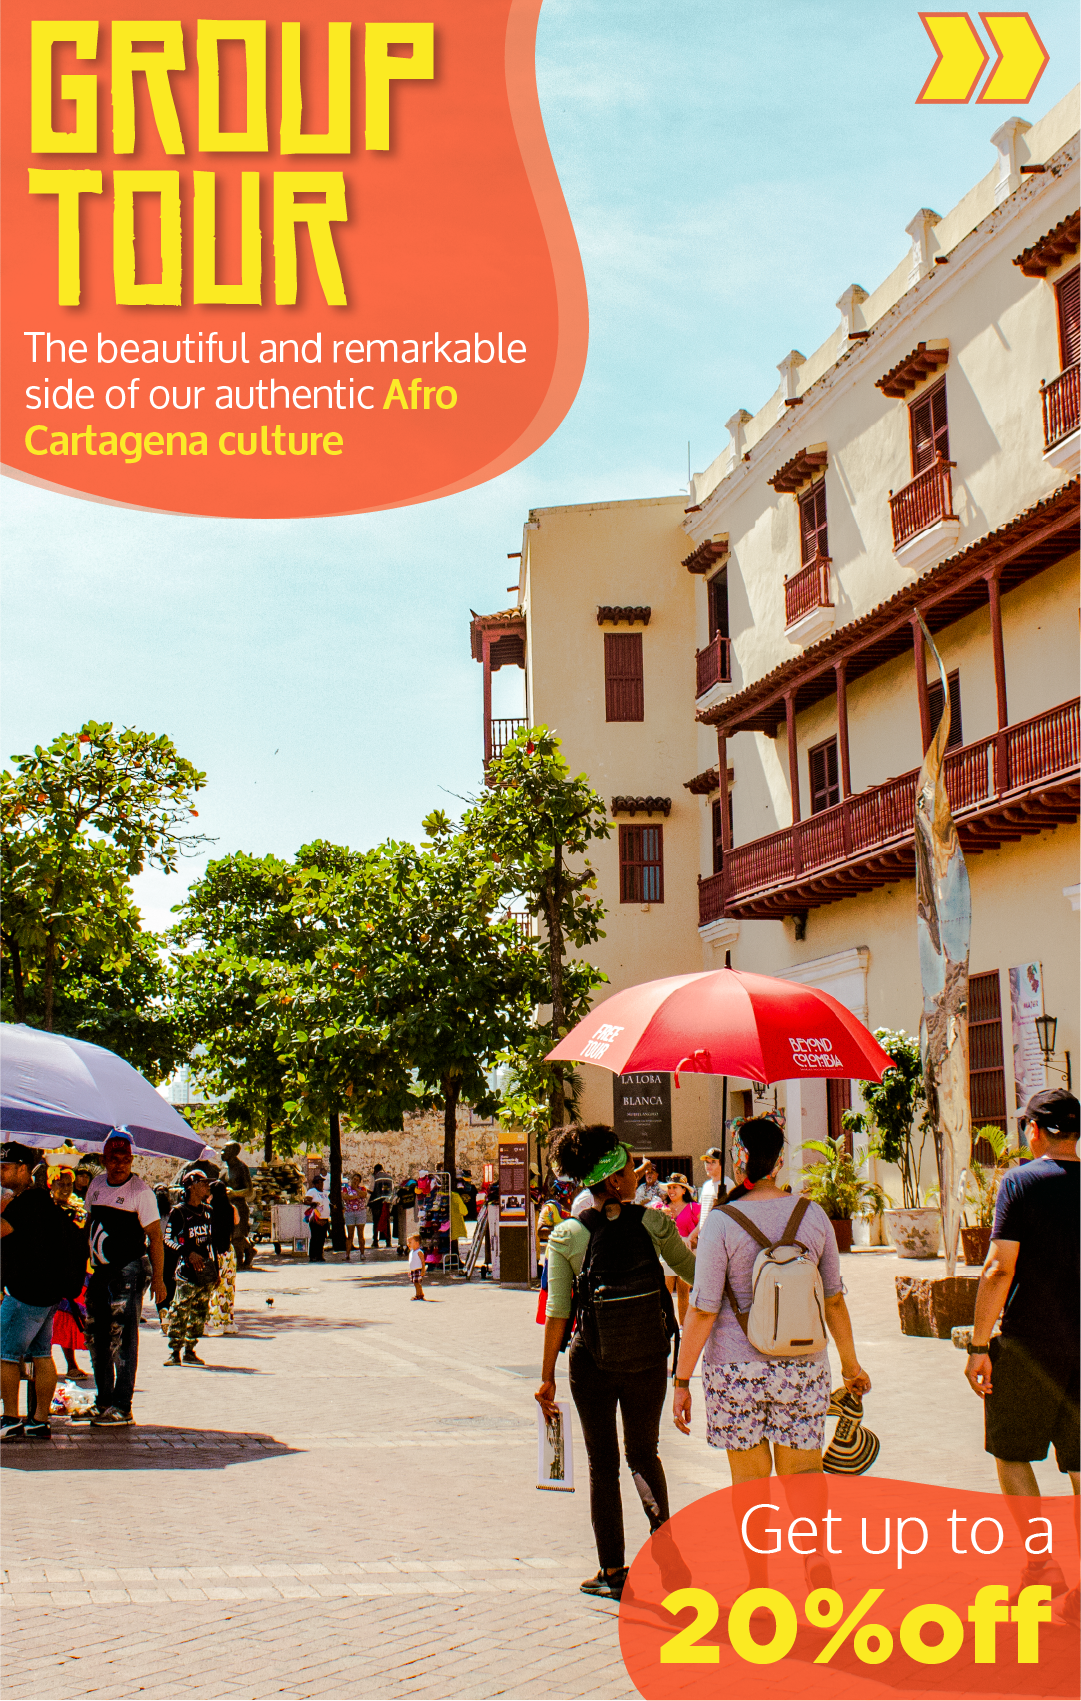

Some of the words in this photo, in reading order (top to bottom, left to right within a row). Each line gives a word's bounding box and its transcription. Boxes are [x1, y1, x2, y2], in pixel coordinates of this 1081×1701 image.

[591, 1023, 625, 1043] FREE
[580, 1040, 610, 1060] TOUR
[788, 1037, 833, 1053] BEYOND
[792, 1053, 844, 1068] COLOMBIA
[621, 1075, 634, 1084] LA
[636, 1074, 662, 1084] LOBA
[623, 1096, 663, 1106] BLANCA
